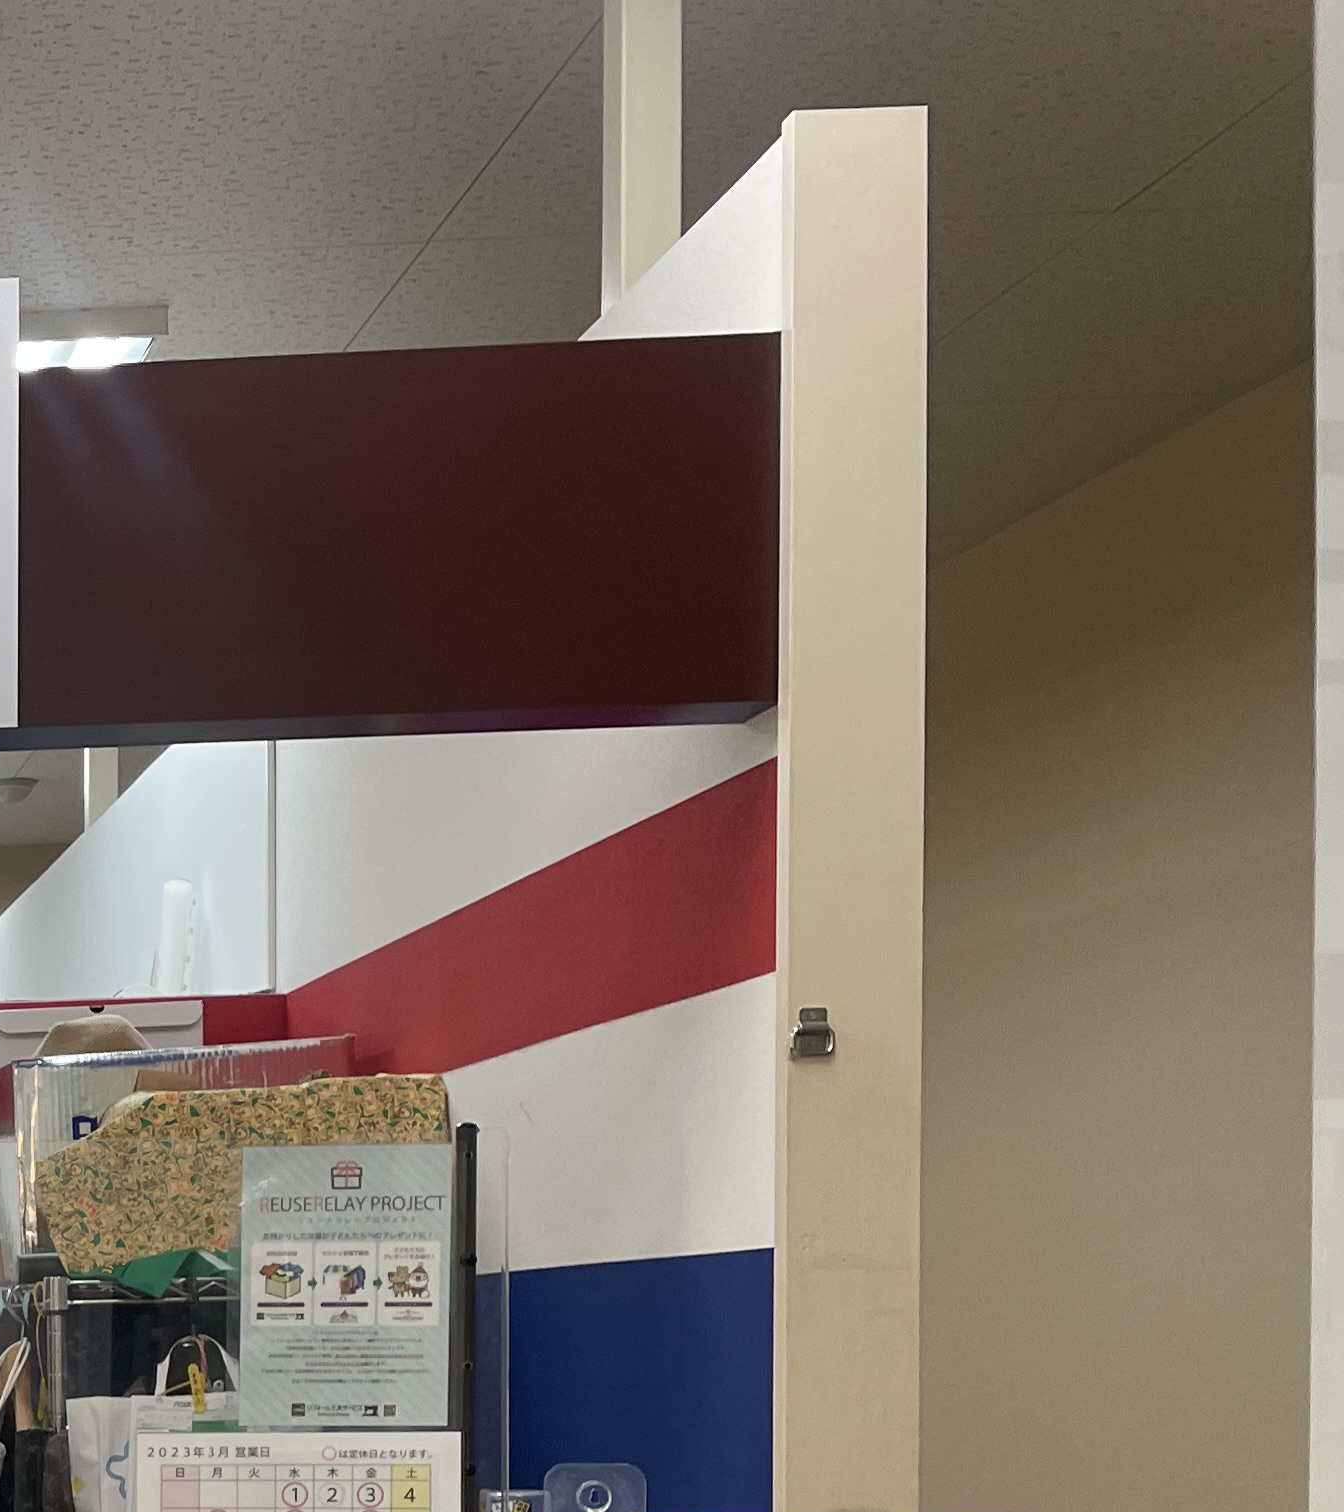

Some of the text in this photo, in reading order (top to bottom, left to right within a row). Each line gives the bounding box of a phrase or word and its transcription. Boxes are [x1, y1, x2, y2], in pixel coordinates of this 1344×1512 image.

[260, 1195, 446, 1212] REUSERELAY PROJECT
[147, 1447, 270, 1458] 2023年3月 営業日
[176, 1467, 417, 1478] 日 月 火 水 木 金 土
[291, 1488, 416, 1502] 1 2 3 4
